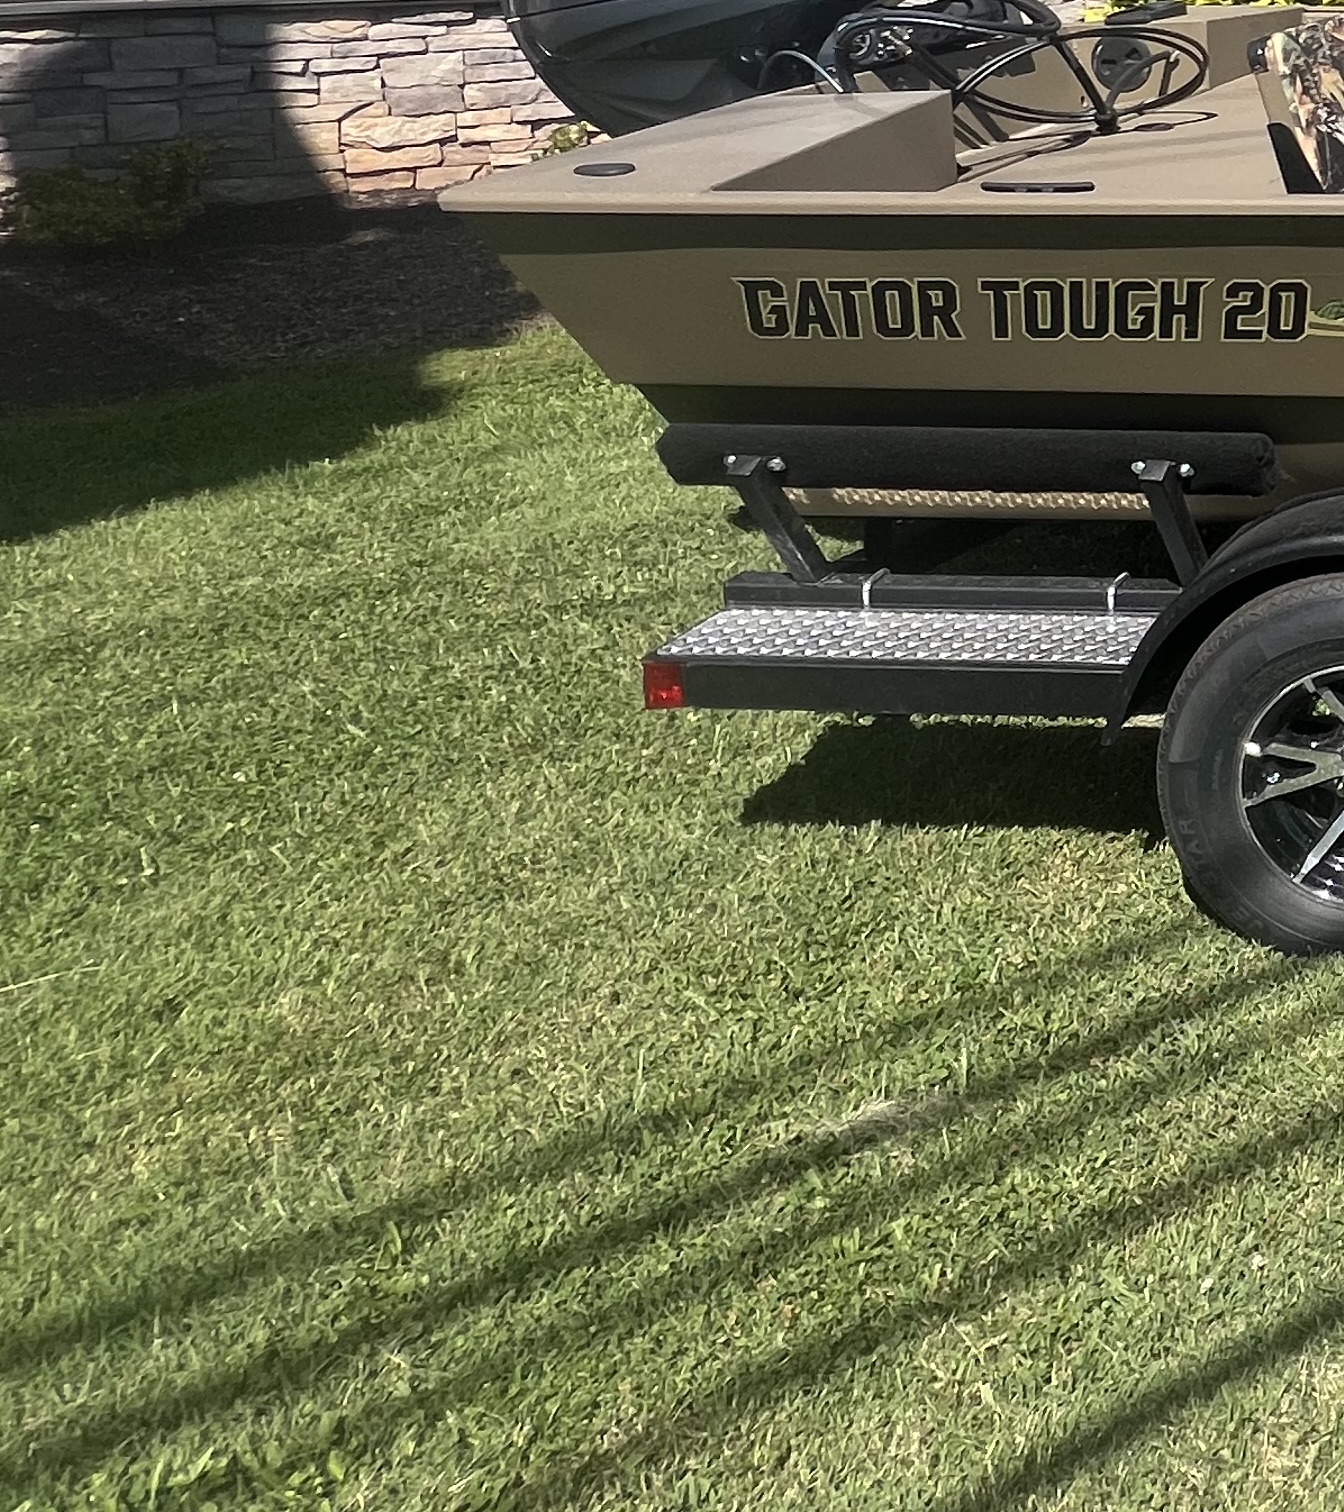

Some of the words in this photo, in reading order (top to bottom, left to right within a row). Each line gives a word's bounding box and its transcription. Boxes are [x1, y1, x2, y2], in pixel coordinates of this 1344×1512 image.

[731, 277, 966, 340] GATOR
[977, 277, 1215, 342] TOUGH
[1220, 279, 1311, 342] 20
